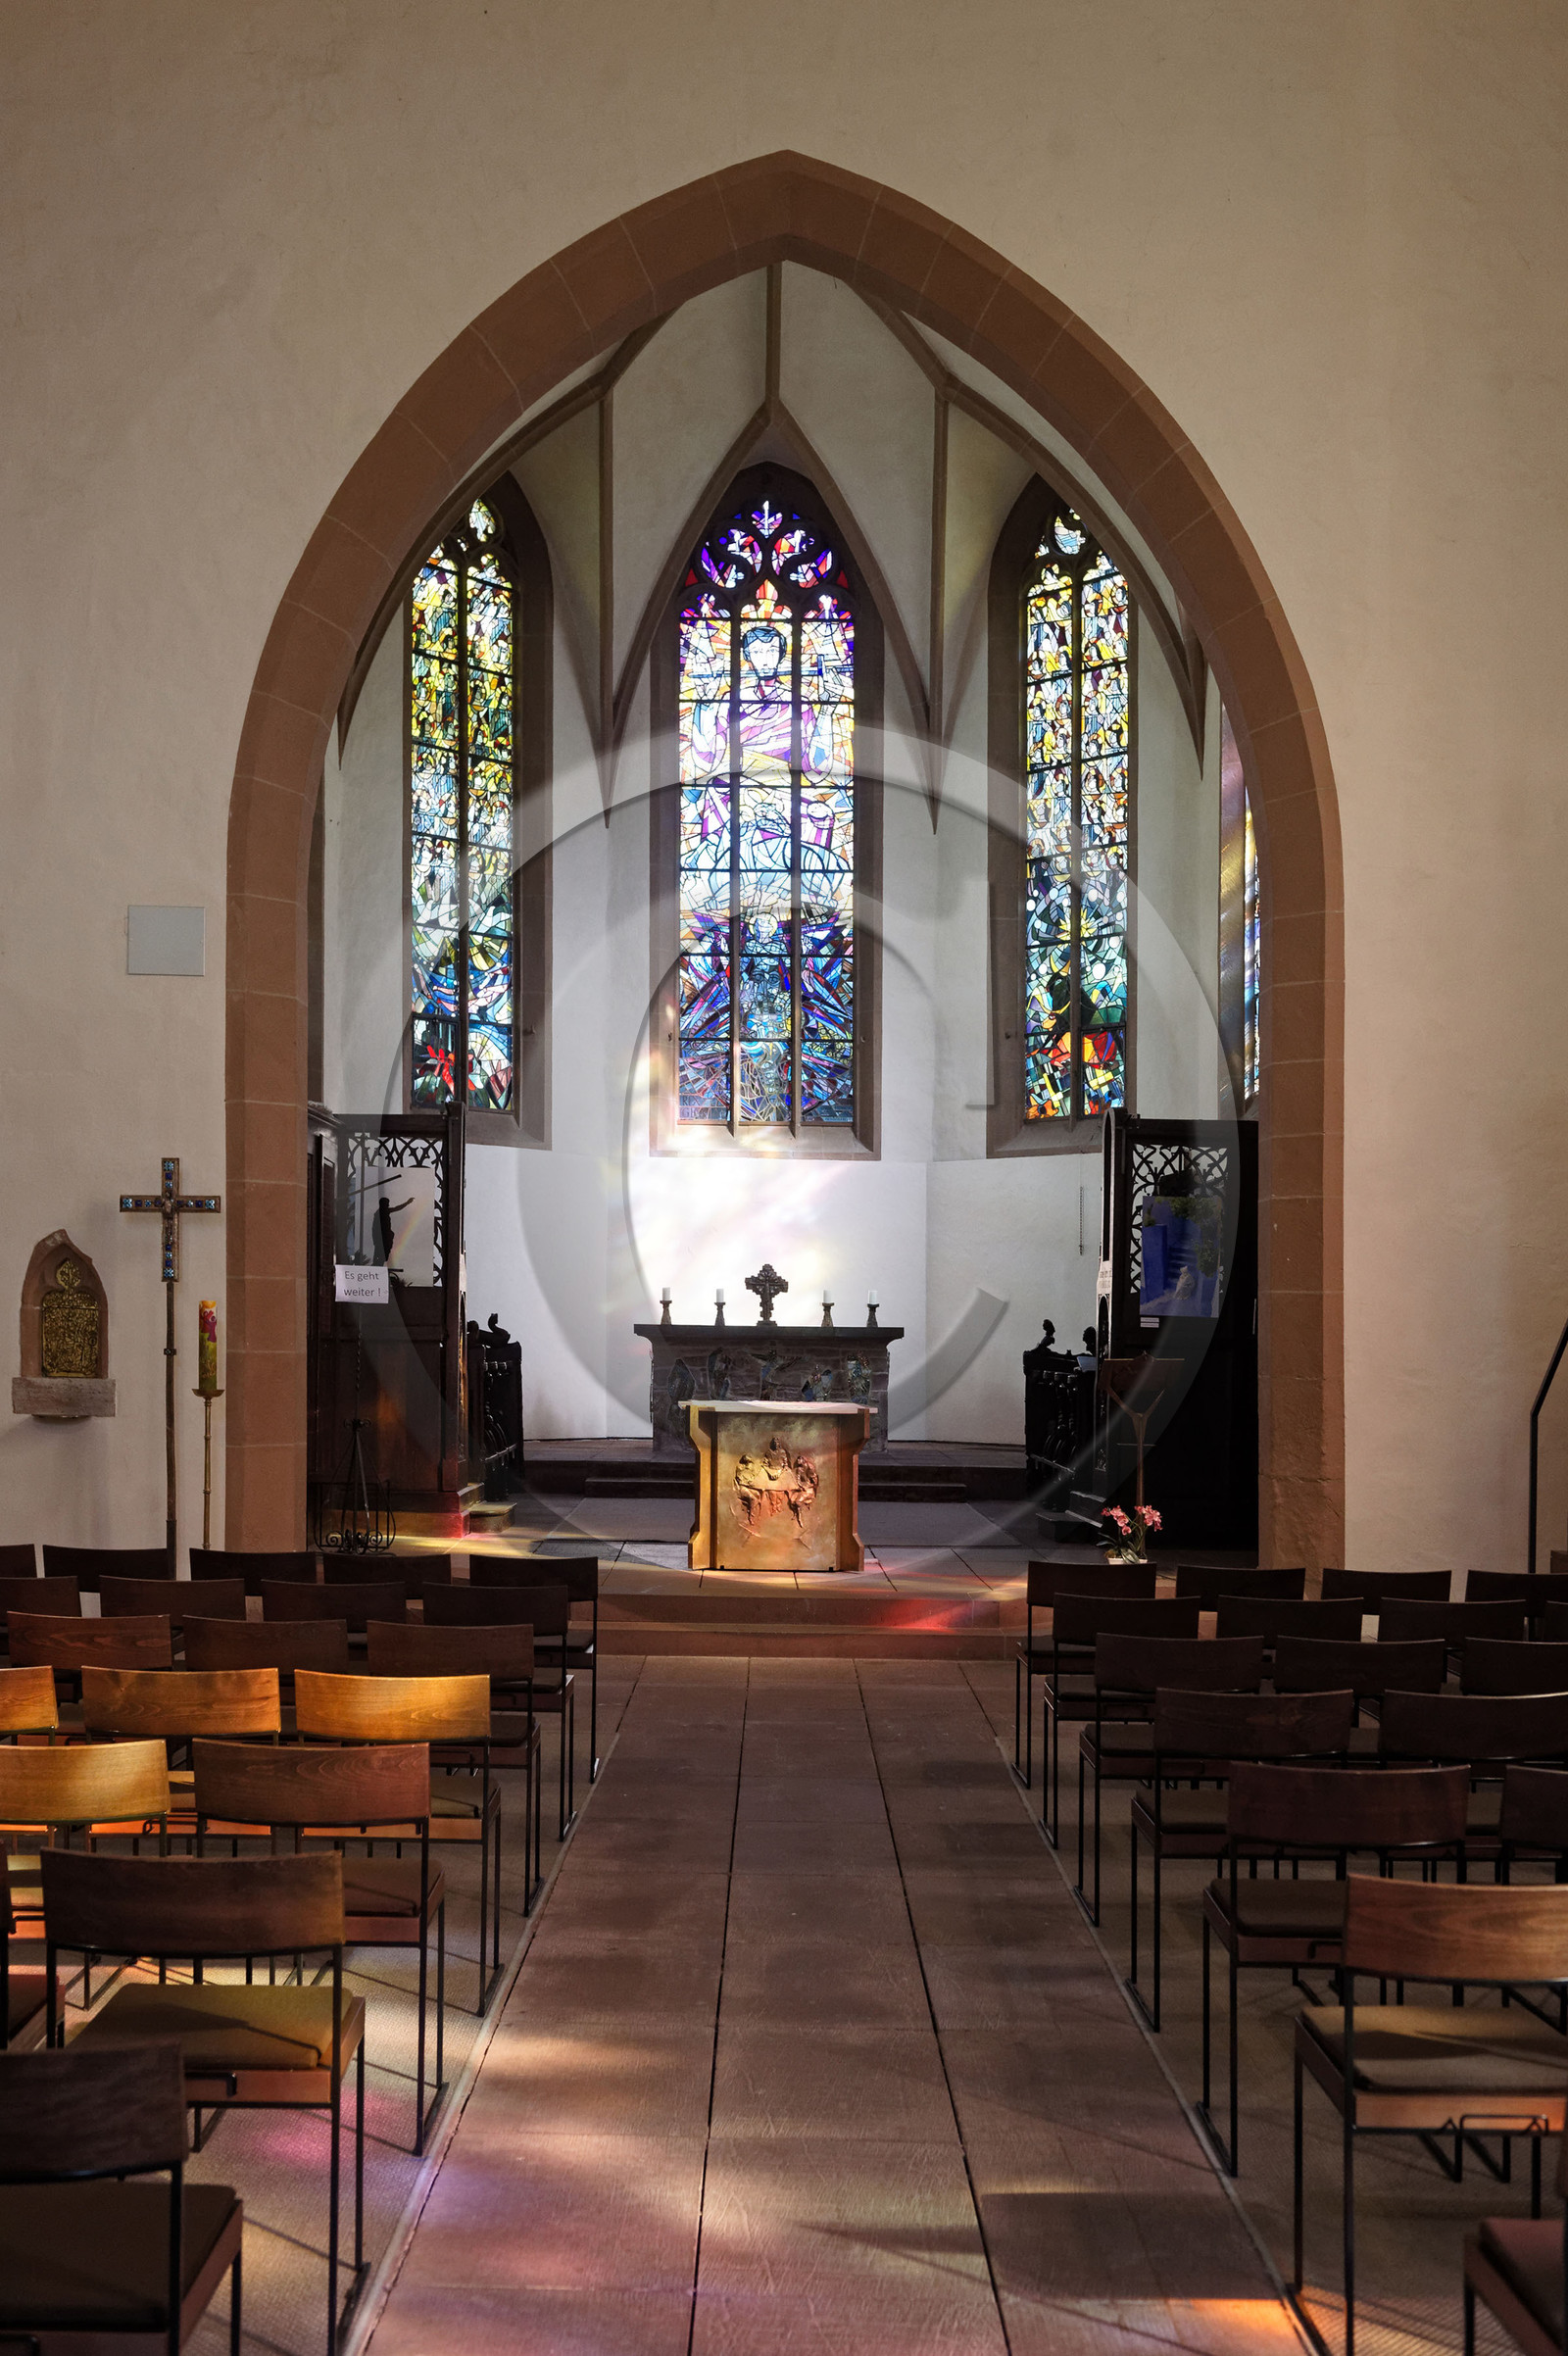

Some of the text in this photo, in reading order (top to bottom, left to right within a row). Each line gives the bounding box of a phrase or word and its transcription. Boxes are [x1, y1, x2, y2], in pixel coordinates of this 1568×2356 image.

[344, 1270, 379, 1282] Es geht
[343, 1287, 374, 1297] weiter
